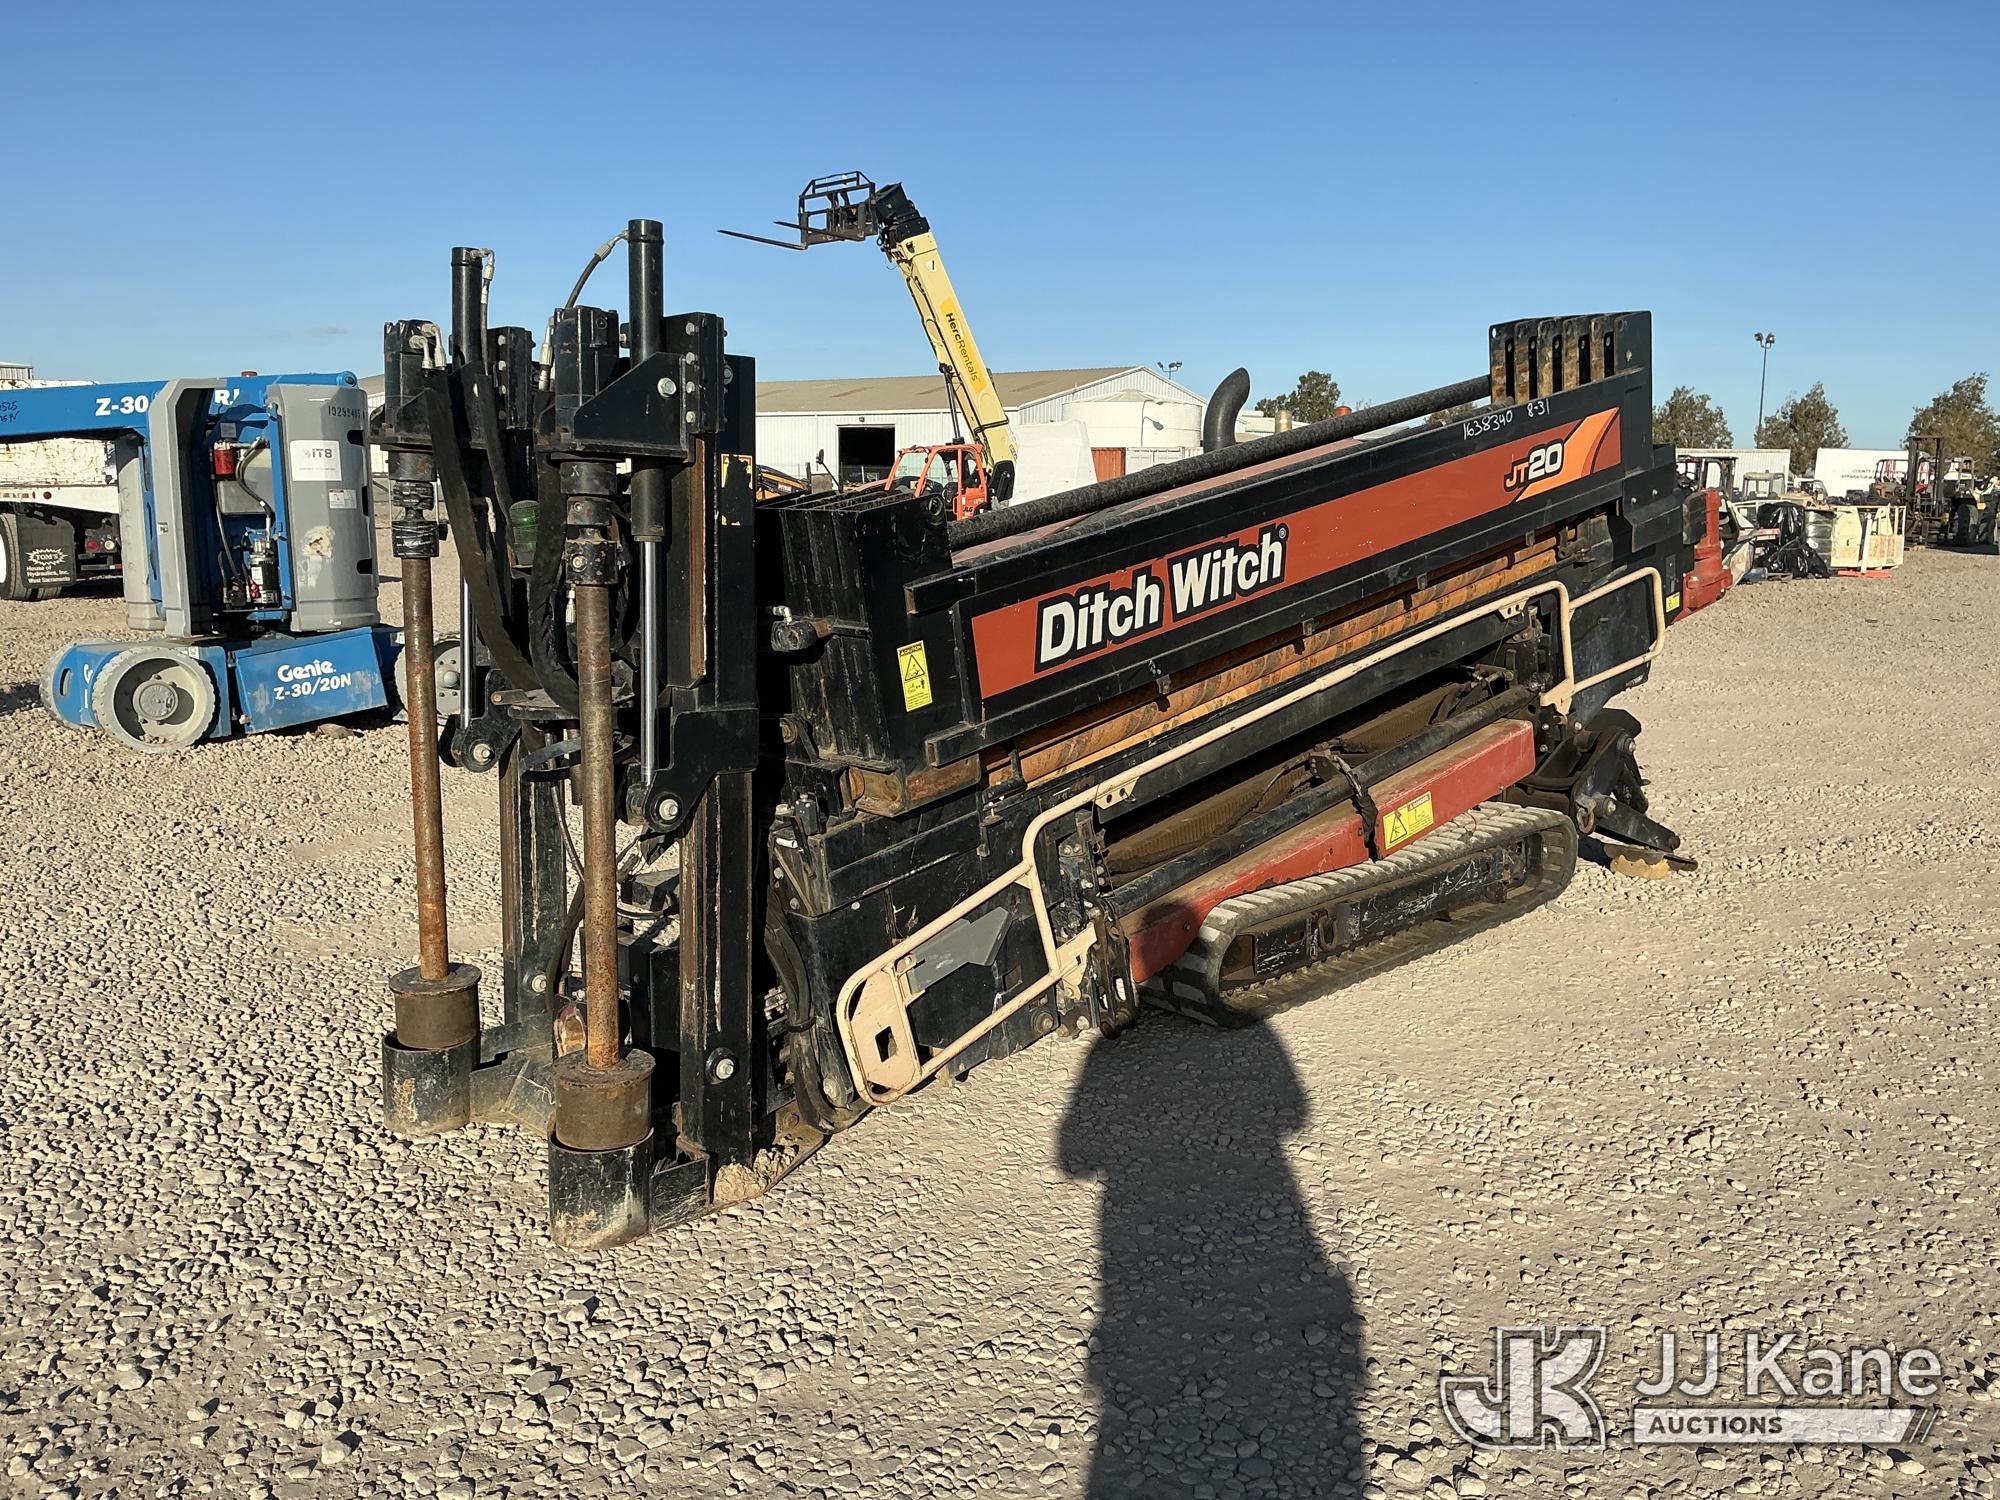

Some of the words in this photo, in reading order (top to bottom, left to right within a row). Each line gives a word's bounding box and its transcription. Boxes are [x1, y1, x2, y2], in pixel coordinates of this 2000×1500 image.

[1463, 410, 1513, 440] 1638340
[1527, 398, 1550, 417] 8-31
[1505, 442, 1563, 488] JT20
[1040, 574, 1160, 664] Ditch
[273, 672, 352, 700] Z-30/20N
[277, 659, 334, 682] Genie
